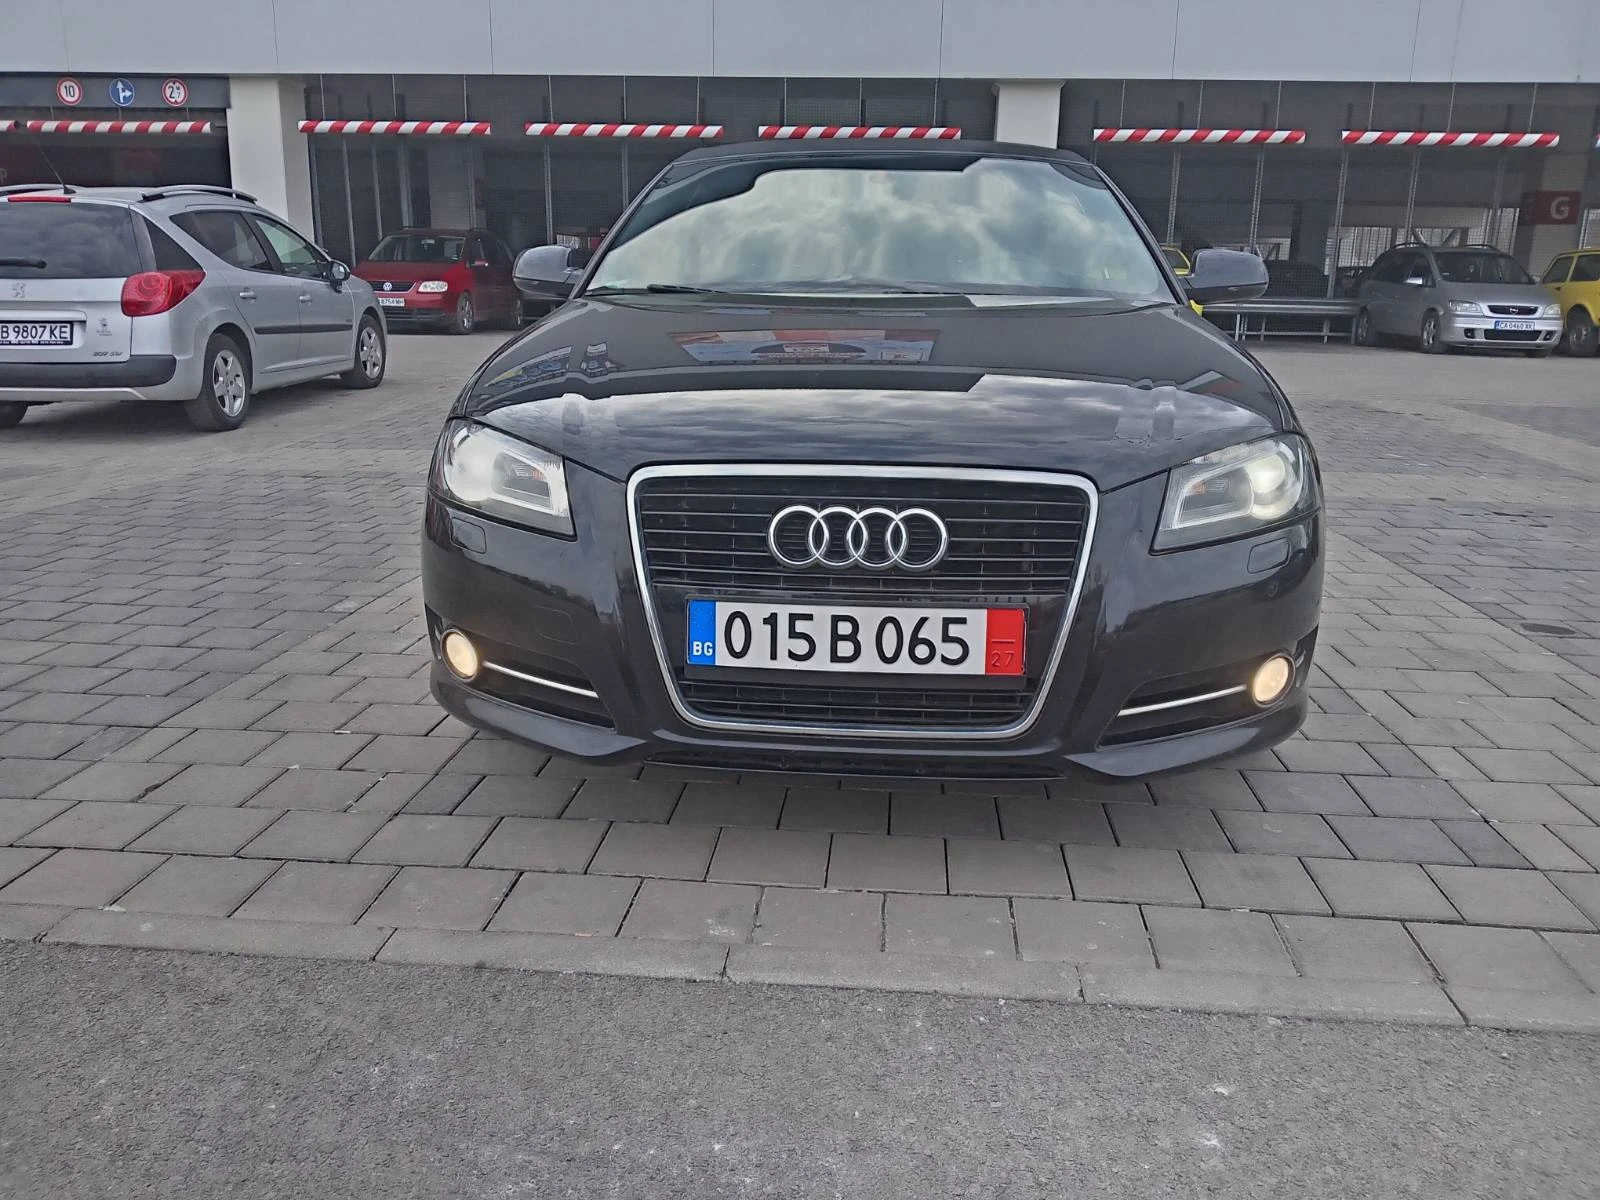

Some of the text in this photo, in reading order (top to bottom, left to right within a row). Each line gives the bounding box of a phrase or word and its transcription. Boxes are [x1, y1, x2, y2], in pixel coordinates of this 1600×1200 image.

[64, 85, 75, 98] 10
[1550, 196, 1570, 220] G
[0, 325, 69, 340] B 9807 KE
[724, 610, 970, 666] 015 B 065
[693, 642, 713, 657] BG
[990, 652, 1015, 667] 27
